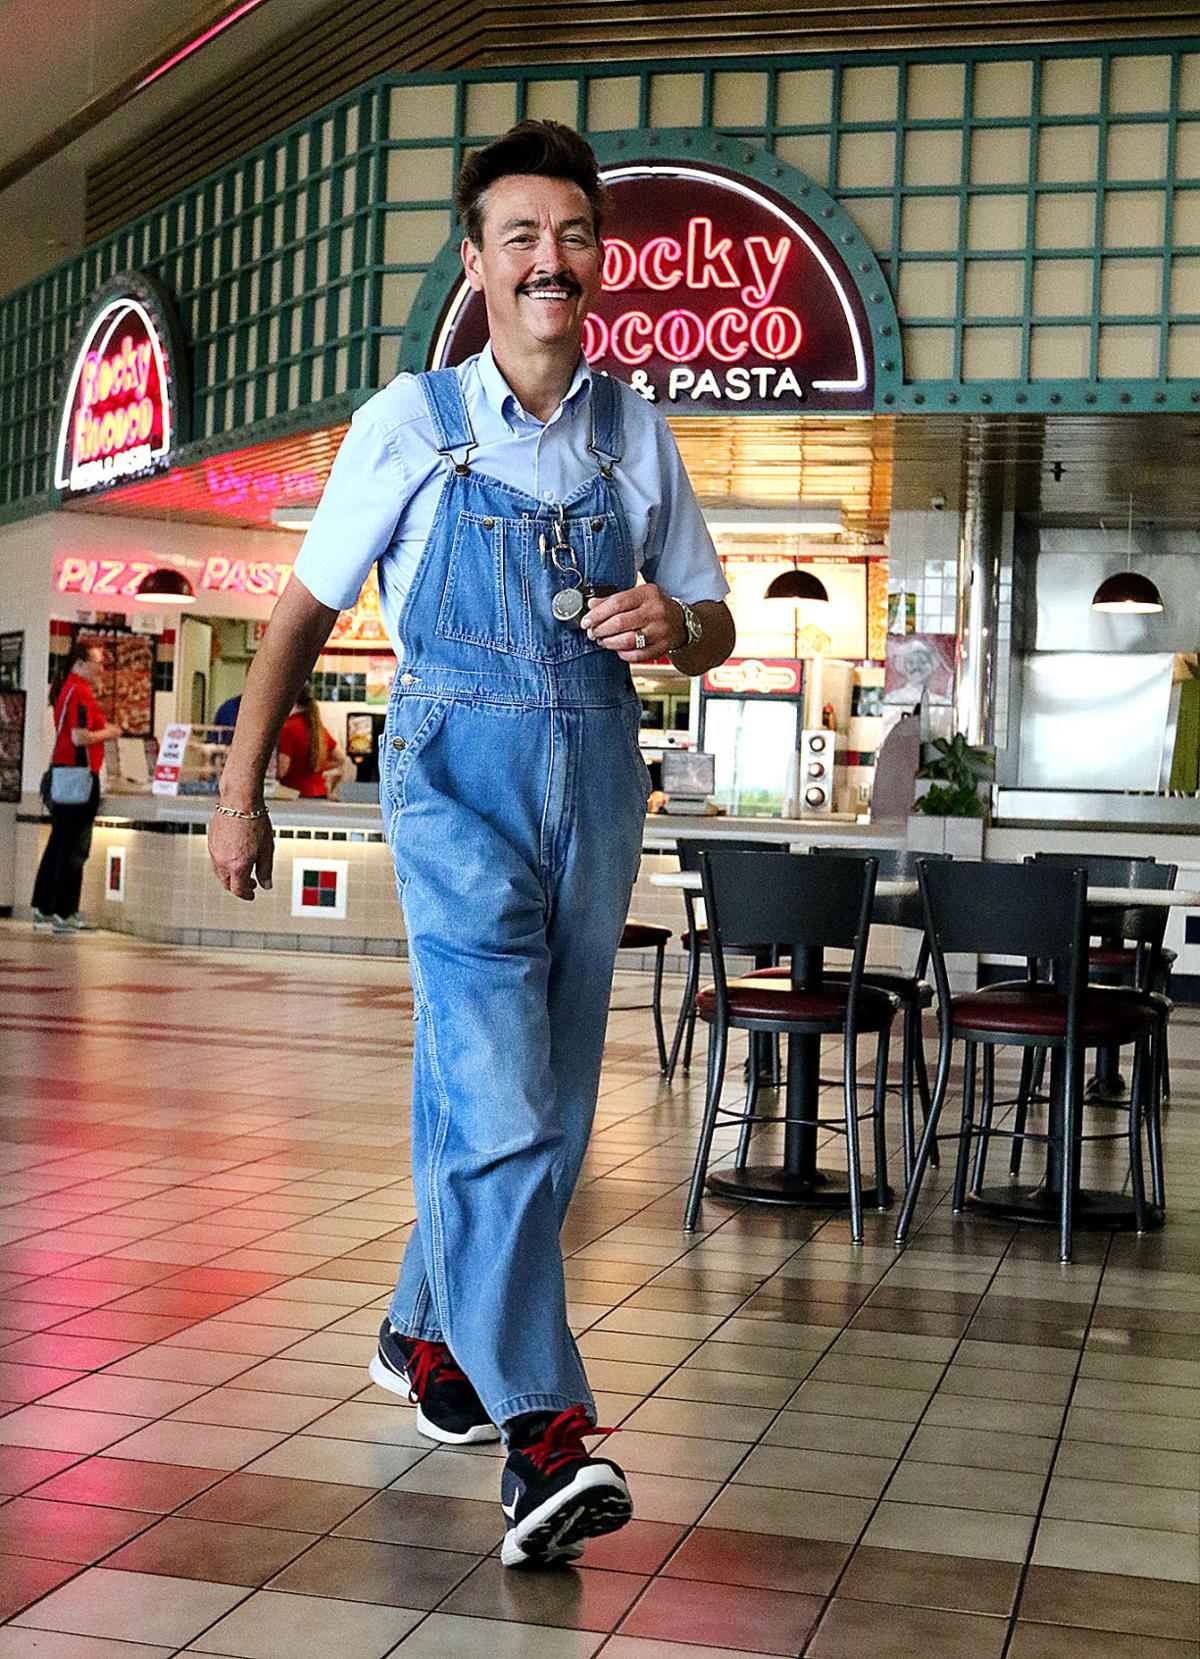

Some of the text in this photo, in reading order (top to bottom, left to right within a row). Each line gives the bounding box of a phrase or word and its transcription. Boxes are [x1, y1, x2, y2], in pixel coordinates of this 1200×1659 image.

[601, 216, 792, 309] ocky
[581, 306, 803, 365] ococo
[629, 367, 803, 401] & PASTA
[57, 556, 293, 597] PIZZ PAST
